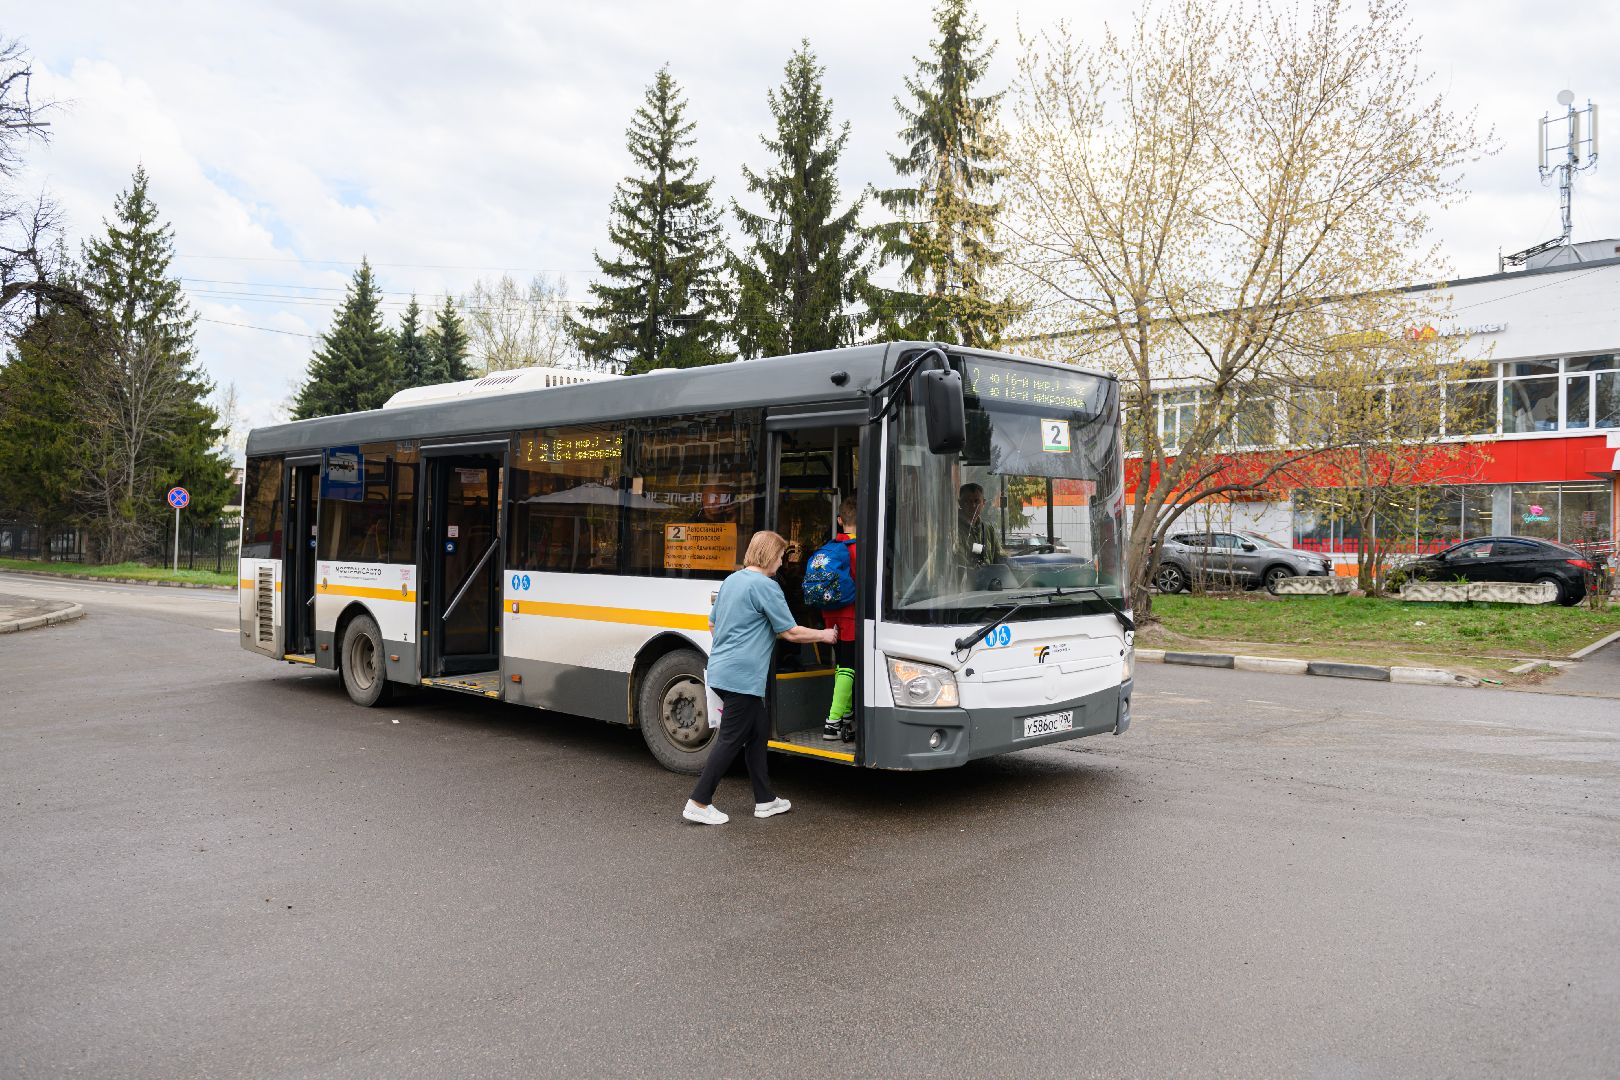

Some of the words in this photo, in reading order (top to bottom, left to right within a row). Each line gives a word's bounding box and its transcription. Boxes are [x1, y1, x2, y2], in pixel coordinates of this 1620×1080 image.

[972, 367, 980, 392] 2
[1050, 425, 1062, 445] 2
[672, 526, 681, 539] 2
